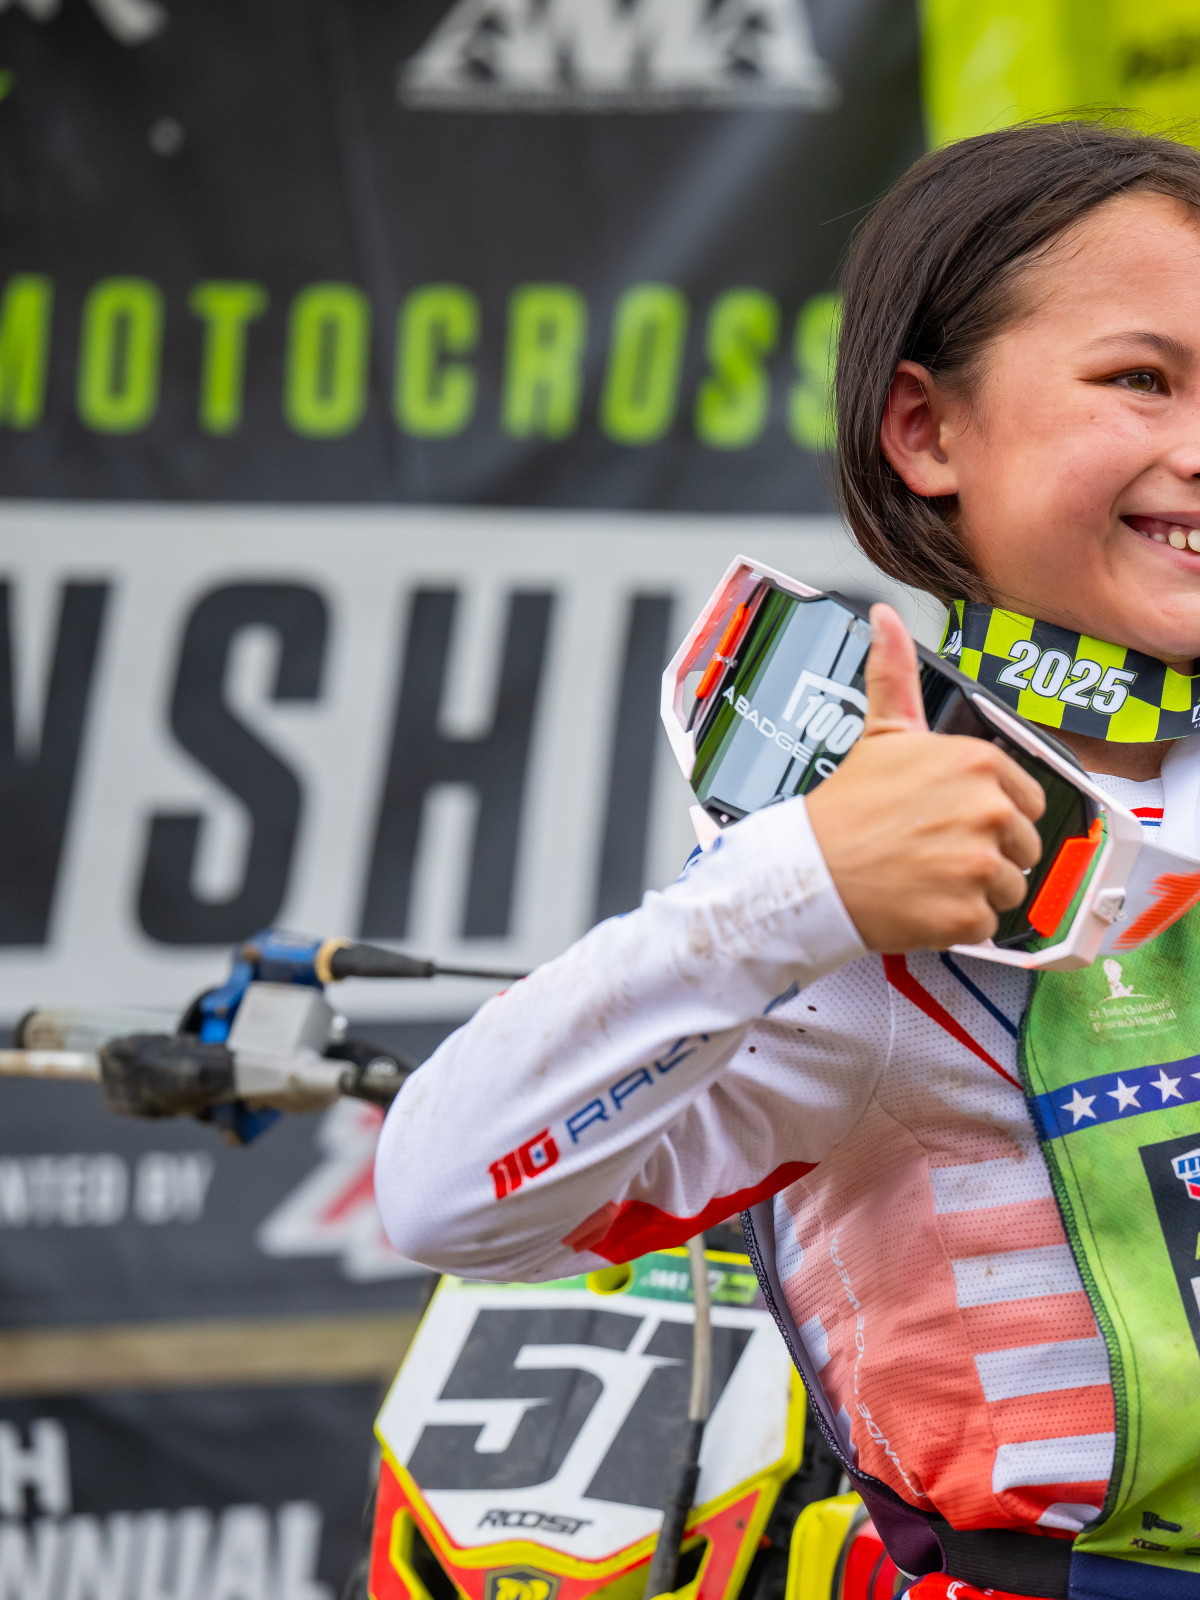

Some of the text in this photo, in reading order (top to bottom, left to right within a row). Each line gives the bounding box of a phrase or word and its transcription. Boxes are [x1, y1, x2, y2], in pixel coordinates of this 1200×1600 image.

[997, 640, 1138, 714] 2025
[0, 572, 685, 946] NSHI
[734, 694, 814, 765] BADGE
[814, 757, 839, 779] O
[565, 1032, 712, 1144] RAC
[404, 1308, 755, 1511] 51
[478, 1508, 593, 1536] ROOST
